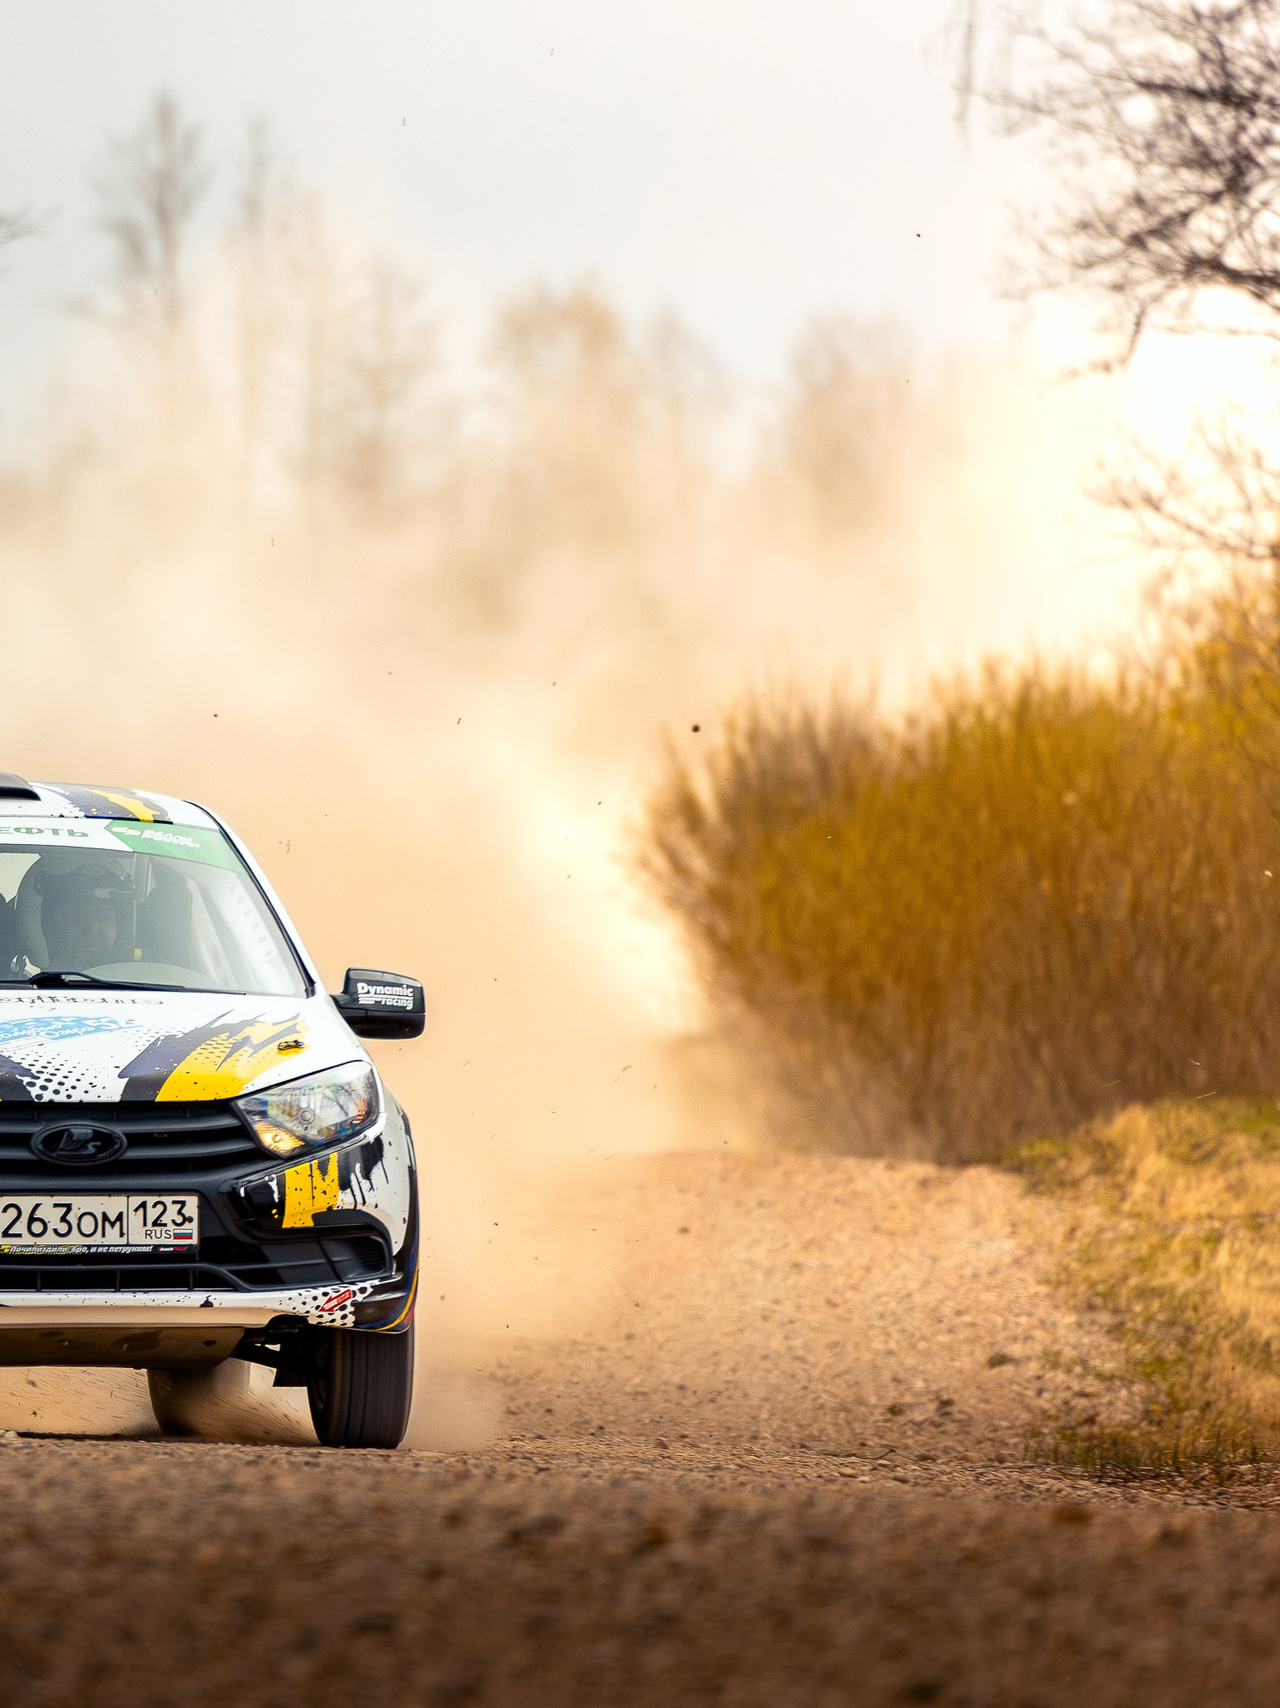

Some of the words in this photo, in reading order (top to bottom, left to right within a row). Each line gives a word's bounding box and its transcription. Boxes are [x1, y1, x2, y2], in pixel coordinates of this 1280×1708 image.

[356, 982, 413, 998] Dynamic
[380, 997, 413, 1010] racing
[133, 1200, 187, 1228] 123
[145, 1229, 172, 1240] RUS
